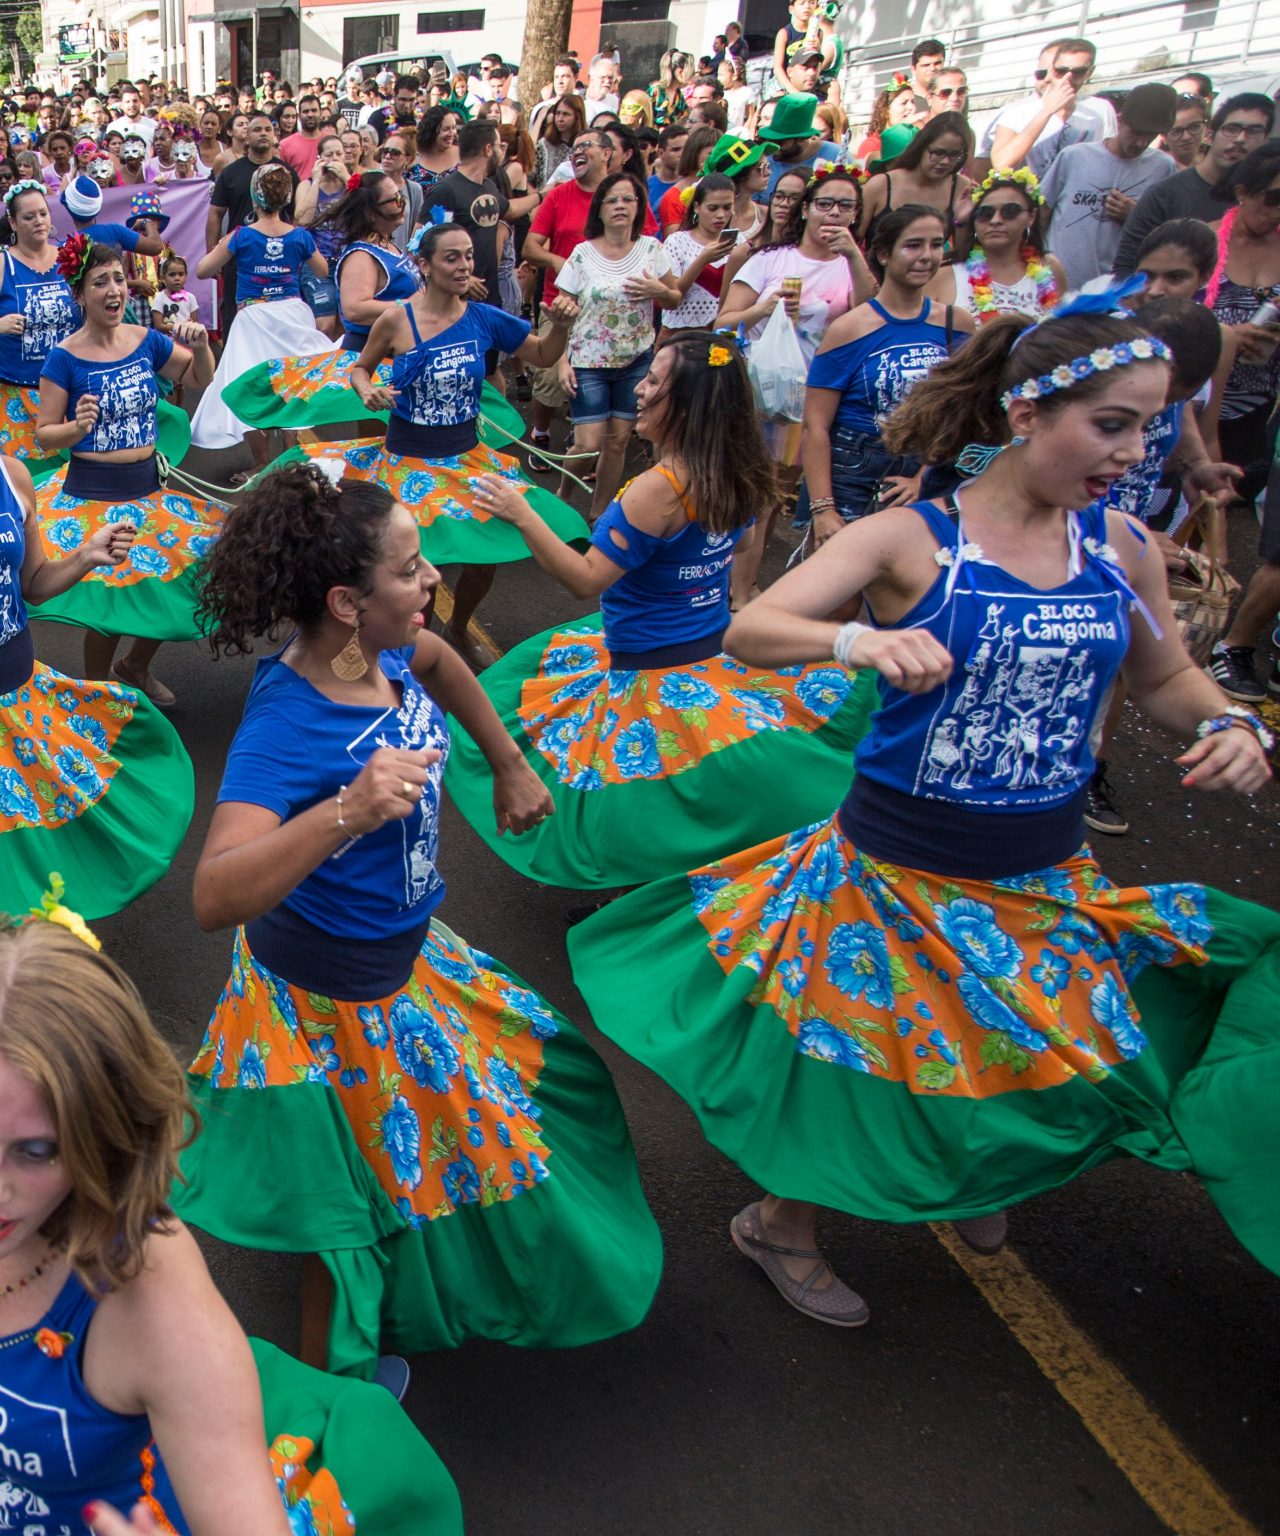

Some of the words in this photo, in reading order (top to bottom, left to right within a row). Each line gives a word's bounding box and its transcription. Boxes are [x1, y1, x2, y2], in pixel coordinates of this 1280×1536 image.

[37, 289, 69, 300] Cangoma
[440, 347, 466, 359] BLOCO
[908, 347, 940, 357] BLOCO
[433, 354, 476, 369] Cangoma
[120, 364, 142, 378] BLOCO
[116, 370, 153, 388] Cangoma
[1036, 605, 1096, 619] BLOCO
[1022, 613, 1116, 645] Cangoma
[396, 688, 418, 726] BLOCO
